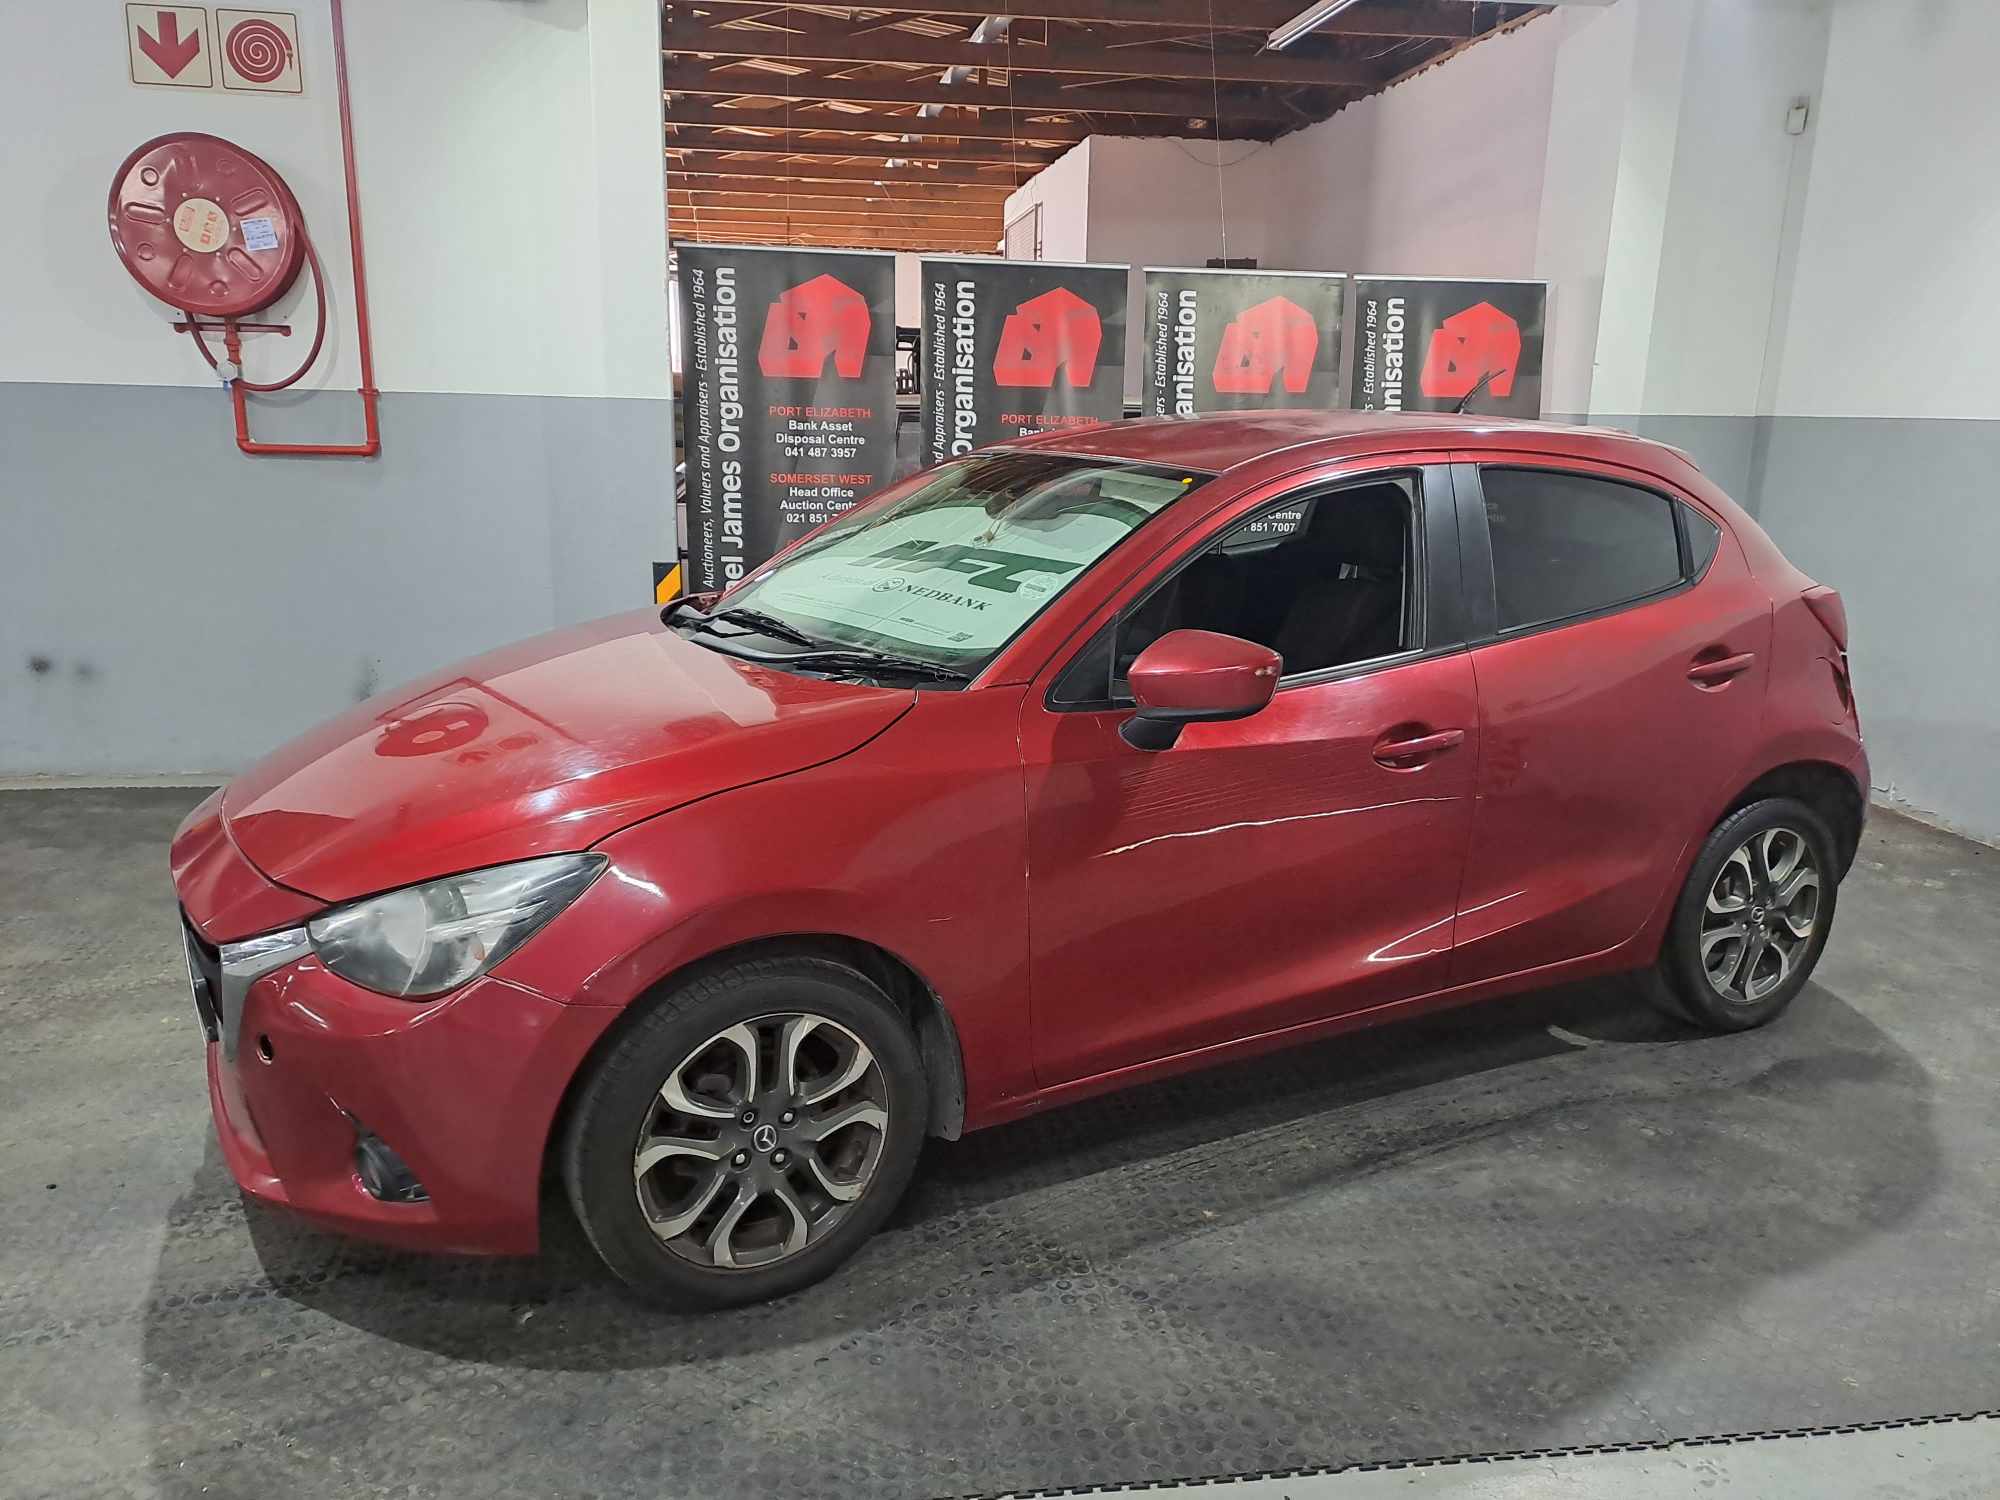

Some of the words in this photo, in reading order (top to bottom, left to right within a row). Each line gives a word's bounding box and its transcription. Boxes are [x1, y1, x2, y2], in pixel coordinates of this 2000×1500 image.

[692, 268, 704, 299] 1964
[933, 282, 946, 312] 1964
[1157, 292, 1169, 320] 1964
[1366, 300, 1377, 328] 1964
[692, 300, 708, 371] Established
[932, 314, 946, 381] Established
[713, 267, 744, 453] Organisation
[1154, 322, 1168, 388] Established
[1172, 290, 1197, 417] anisation
[1363, 330, 1376, 394] Established
[696, 381, 713, 444] Appraisers
[769, 406, 801, 416] PORT
[805, 407, 871, 418] ELIZABETH
[788, 420, 817, 430] Bank
[820, 421, 853, 431] Asset
[932, 389, 947, 450] Appraisers
[1001, 414, 1032, 424] PORT
[1035, 415, 1098, 425] ELIZABETH
[776, 433, 825, 445] Disposal
[828, 434, 865, 445] Centre
[785, 447, 804, 457] 041
[808, 447, 827, 457] 487
[831, 448, 857, 458] 3957
[699, 445, 711, 467] and
[700, 471, 712, 514] Valuers
[769, 473, 836, 484] SOMERSET
[839, 474, 873, 485] WEST
[789, 487, 818, 497] Head
[821, 487, 854, 497] Office
[720, 461, 744, 549] James
[779, 500, 823, 510] Auction
[826, 500, 858, 510] Cent
[786, 513, 805, 523] 021
[809, 513, 828, 523] 851
[1250, 522, 1268, 532] 851
[1271, 522, 1296, 532] 7007
[701, 518, 715, 588] Auctioneers,
[900, 584, 993, 612] NEDBANK
